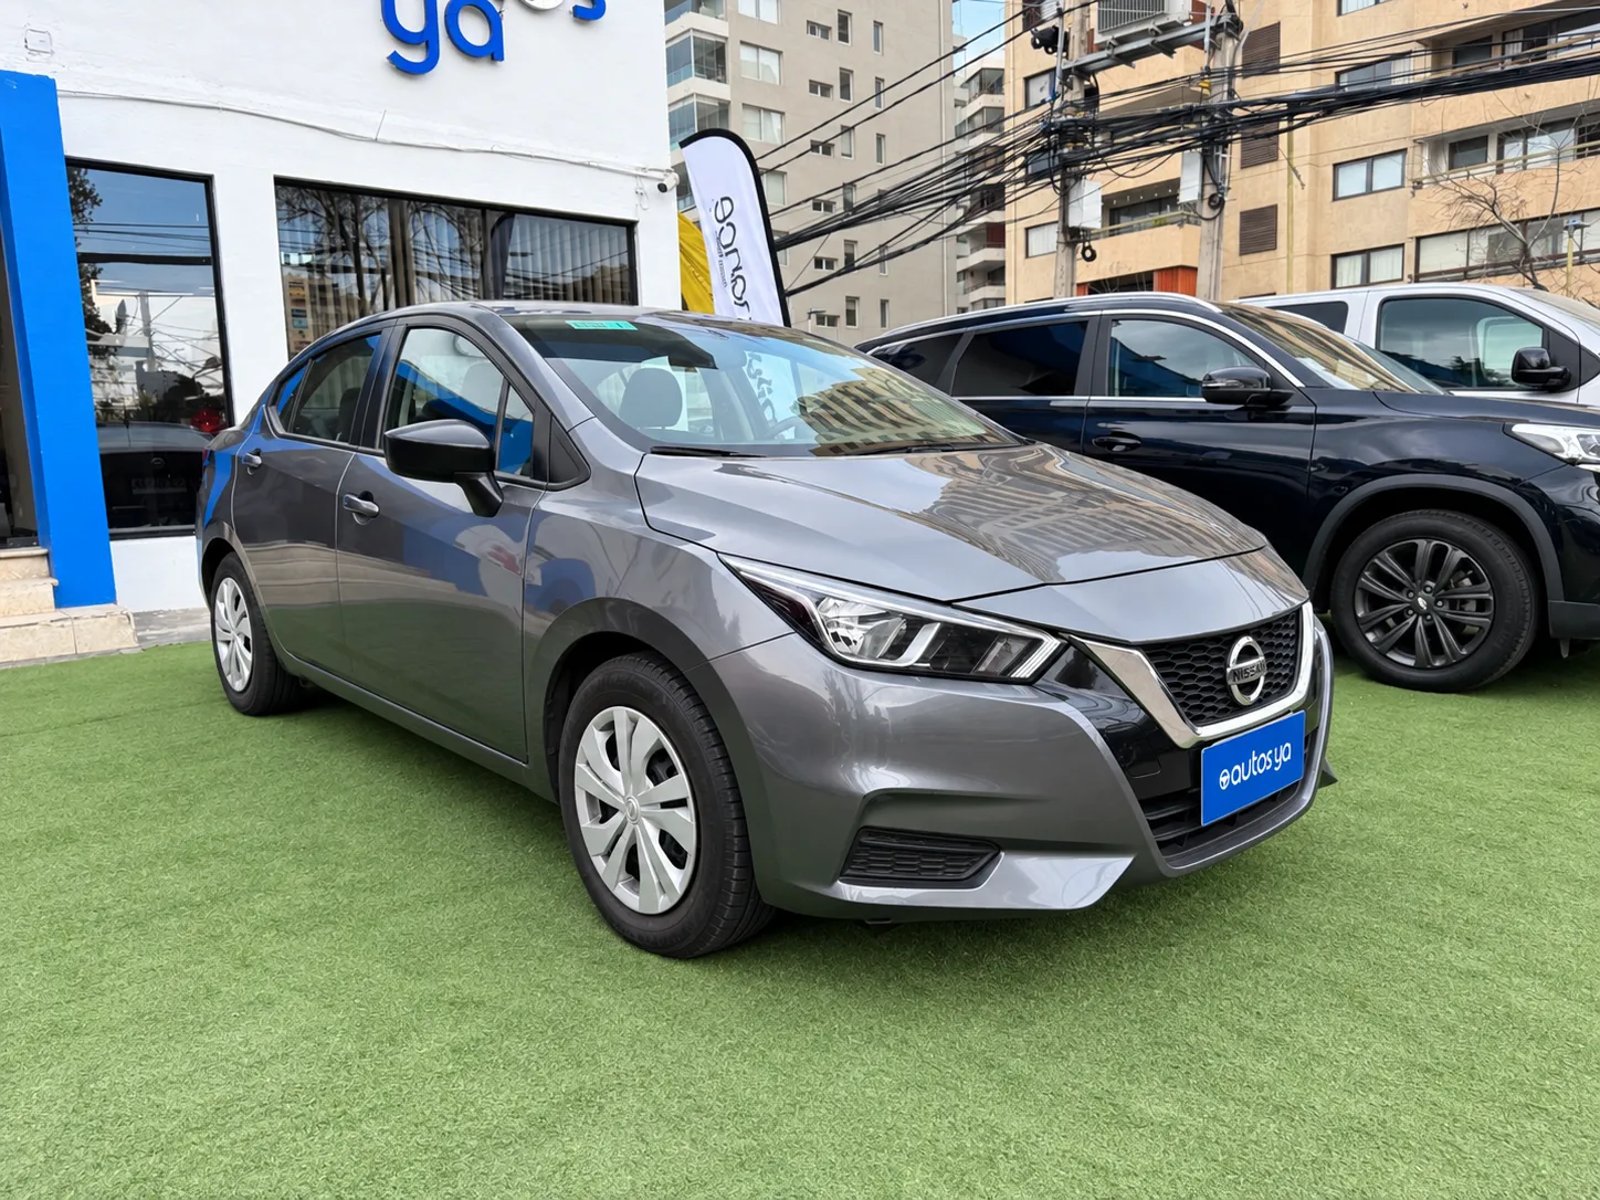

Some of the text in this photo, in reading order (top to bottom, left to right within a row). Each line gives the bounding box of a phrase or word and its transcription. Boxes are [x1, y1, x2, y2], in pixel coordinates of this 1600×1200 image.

[381, 0, 504, 75] ya
[1232, 660, 1266, 682] NISSAN
[1231, 742, 1292, 786] autos ya
